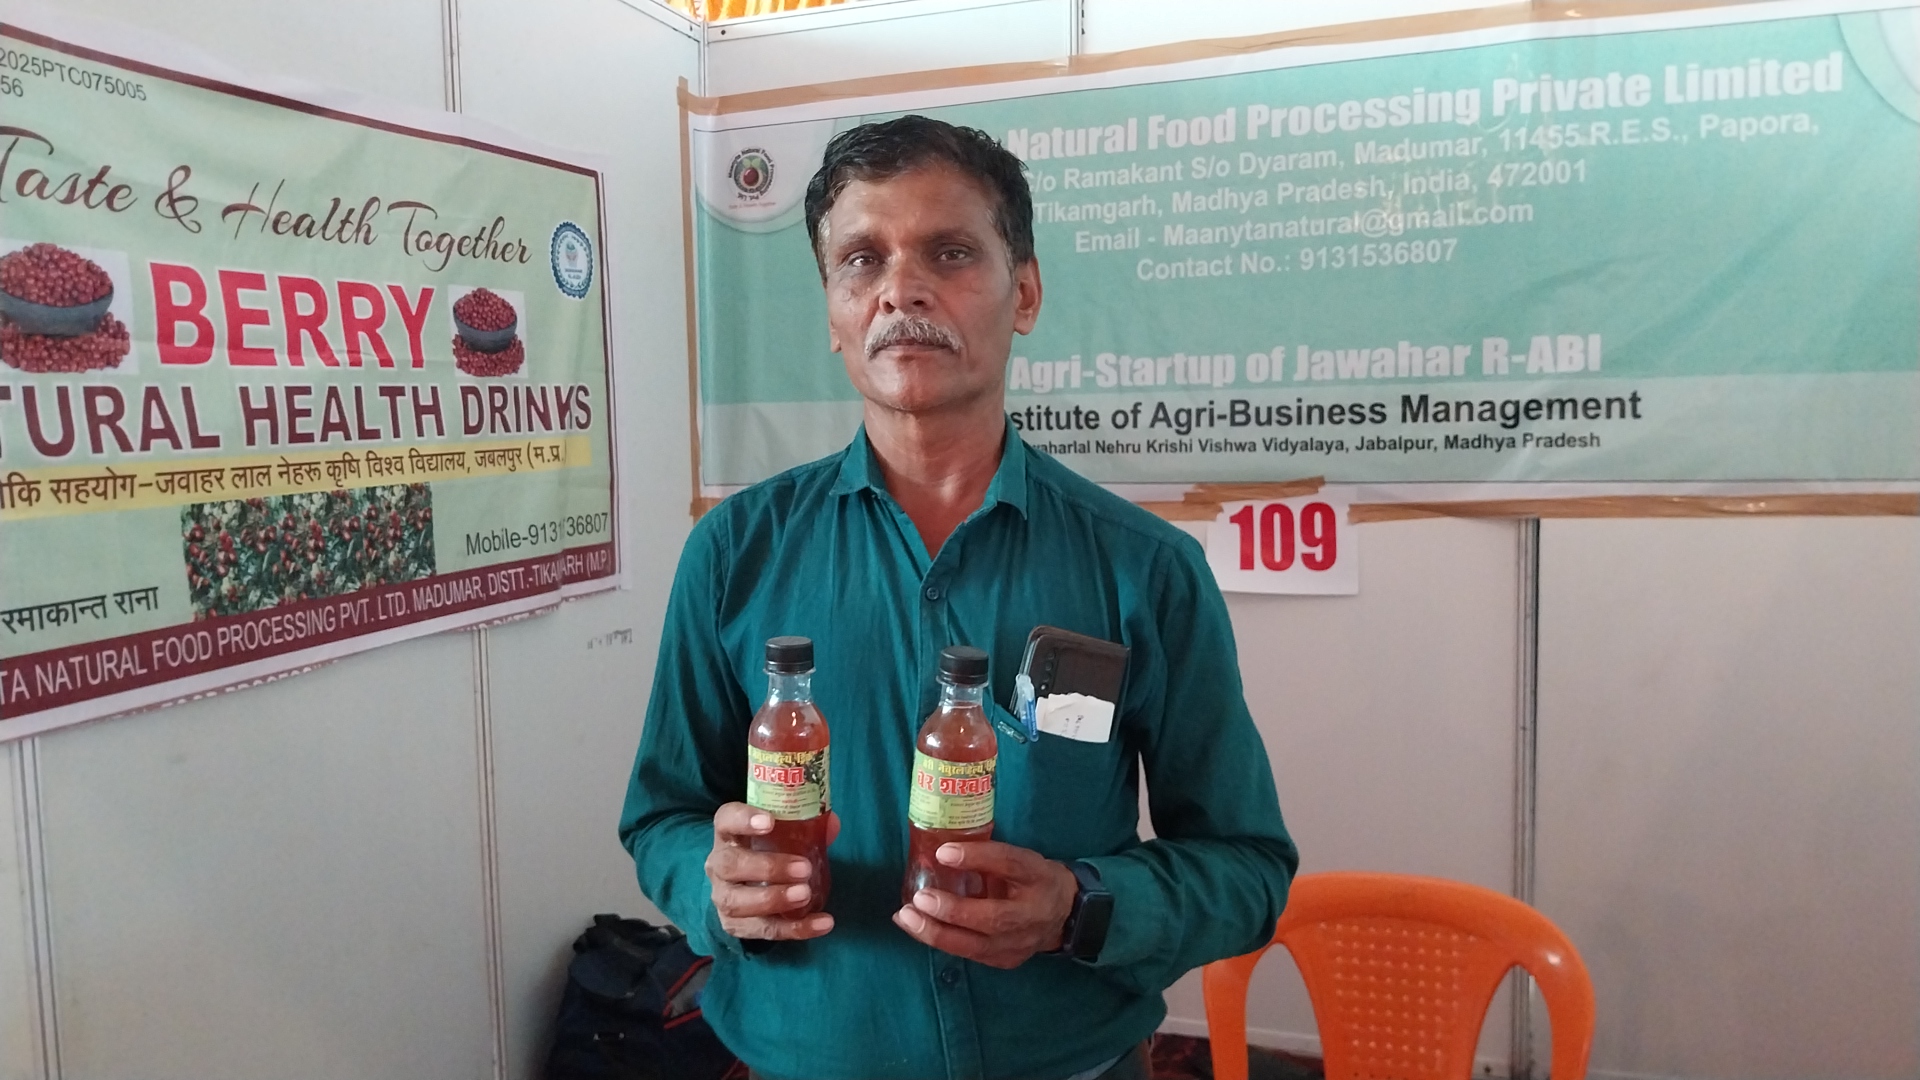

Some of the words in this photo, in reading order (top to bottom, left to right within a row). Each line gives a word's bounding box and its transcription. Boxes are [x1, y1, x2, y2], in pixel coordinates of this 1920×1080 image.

[1, 75, 24, 98] 56
[1007, 117, 1138, 161] Natural
[1148, 106, 1237, 150] Food
[1246, 87, 1481, 140] Processing
[1492, 71, 1652, 117] Private
[1664, 50, 1844, 104] Limited
[1064, 160, 1185, 190] Ramakant
[1190, 155, 1231, 180] S/o
[1239, 149, 1345, 180] Dyaram,
[1354, 136, 1489, 166] Madumar,
[1700, 112, 1819, 142] Papora,
[0, 125, 138, 212] Taste
[154, 165, 202, 233] &
[220, 179, 380, 245] Health
[387, 200, 533, 272] Together
[1032, 194, 1163, 225] Tikamgarh,
[1172, 187, 1269, 214] Madhya
[1277, 174, 1394, 205] Pradesh,
[1403, 168, 1478, 194] India,
[1487, 158, 1586, 188] 472001
[1075, 227, 1141, 253] Email
[1163, 202, 1535, 248] Maanytanatural@gmail.com
[1136, 254, 1233, 282] Contact
[1241, 251, 1291, 275] No.:
[1300, 237, 1458, 271] 9131536807
[150, 262, 435, 368] BERRY
[1008, 352, 1237, 394] Agri-Startup
[1246, 345, 1287, 384] of
[1293, 340, 1473, 382] Jawahar
[1481, 333, 1602, 376] R-ABI
[239, 385, 445, 447] HEALTH
[460, 384, 593, 435] DRINKS
[1010, 404, 1100, 432] stitute
[1111, 402, 1143, 429] of
[1149, 396, 1388, 436] Agri-Business
[1401, 389, 1643, 430] Management
[230, 465, 272, 488] लाल
[325, 451, 361, 487] कृषि
[365, 449, 406, 478] विश्व
[475, 448, 523, 472] जबलपुर
[1095, 439, 1142, 454] Nehru
[1147, 438, 1193, 453] Krishi
[1198, 437, 1257, 453] Vishwa
[1262, 436, 1350, 456] Vidyalaya,
[1355, 436, 1438, 454] Jabalpur,
[1444, 434, 1516, 453] Madhya
[1523, 431, 1601, 449] Pradesh
[1229, 501, 1338, 572] 109
[113, 586, 159, 614] राना
[35, 644, 148, 697] NATURAL
[152, 630, 213, 672] FOOD
[217, 604, 336, 656] PROCESSING
[340, 597, 375, 628] PVT.
[377, 591, 411, 620] LTD.
[412, 575, 487, 613] MADUMAR,
[939, 773, 992, 796] शरबत
